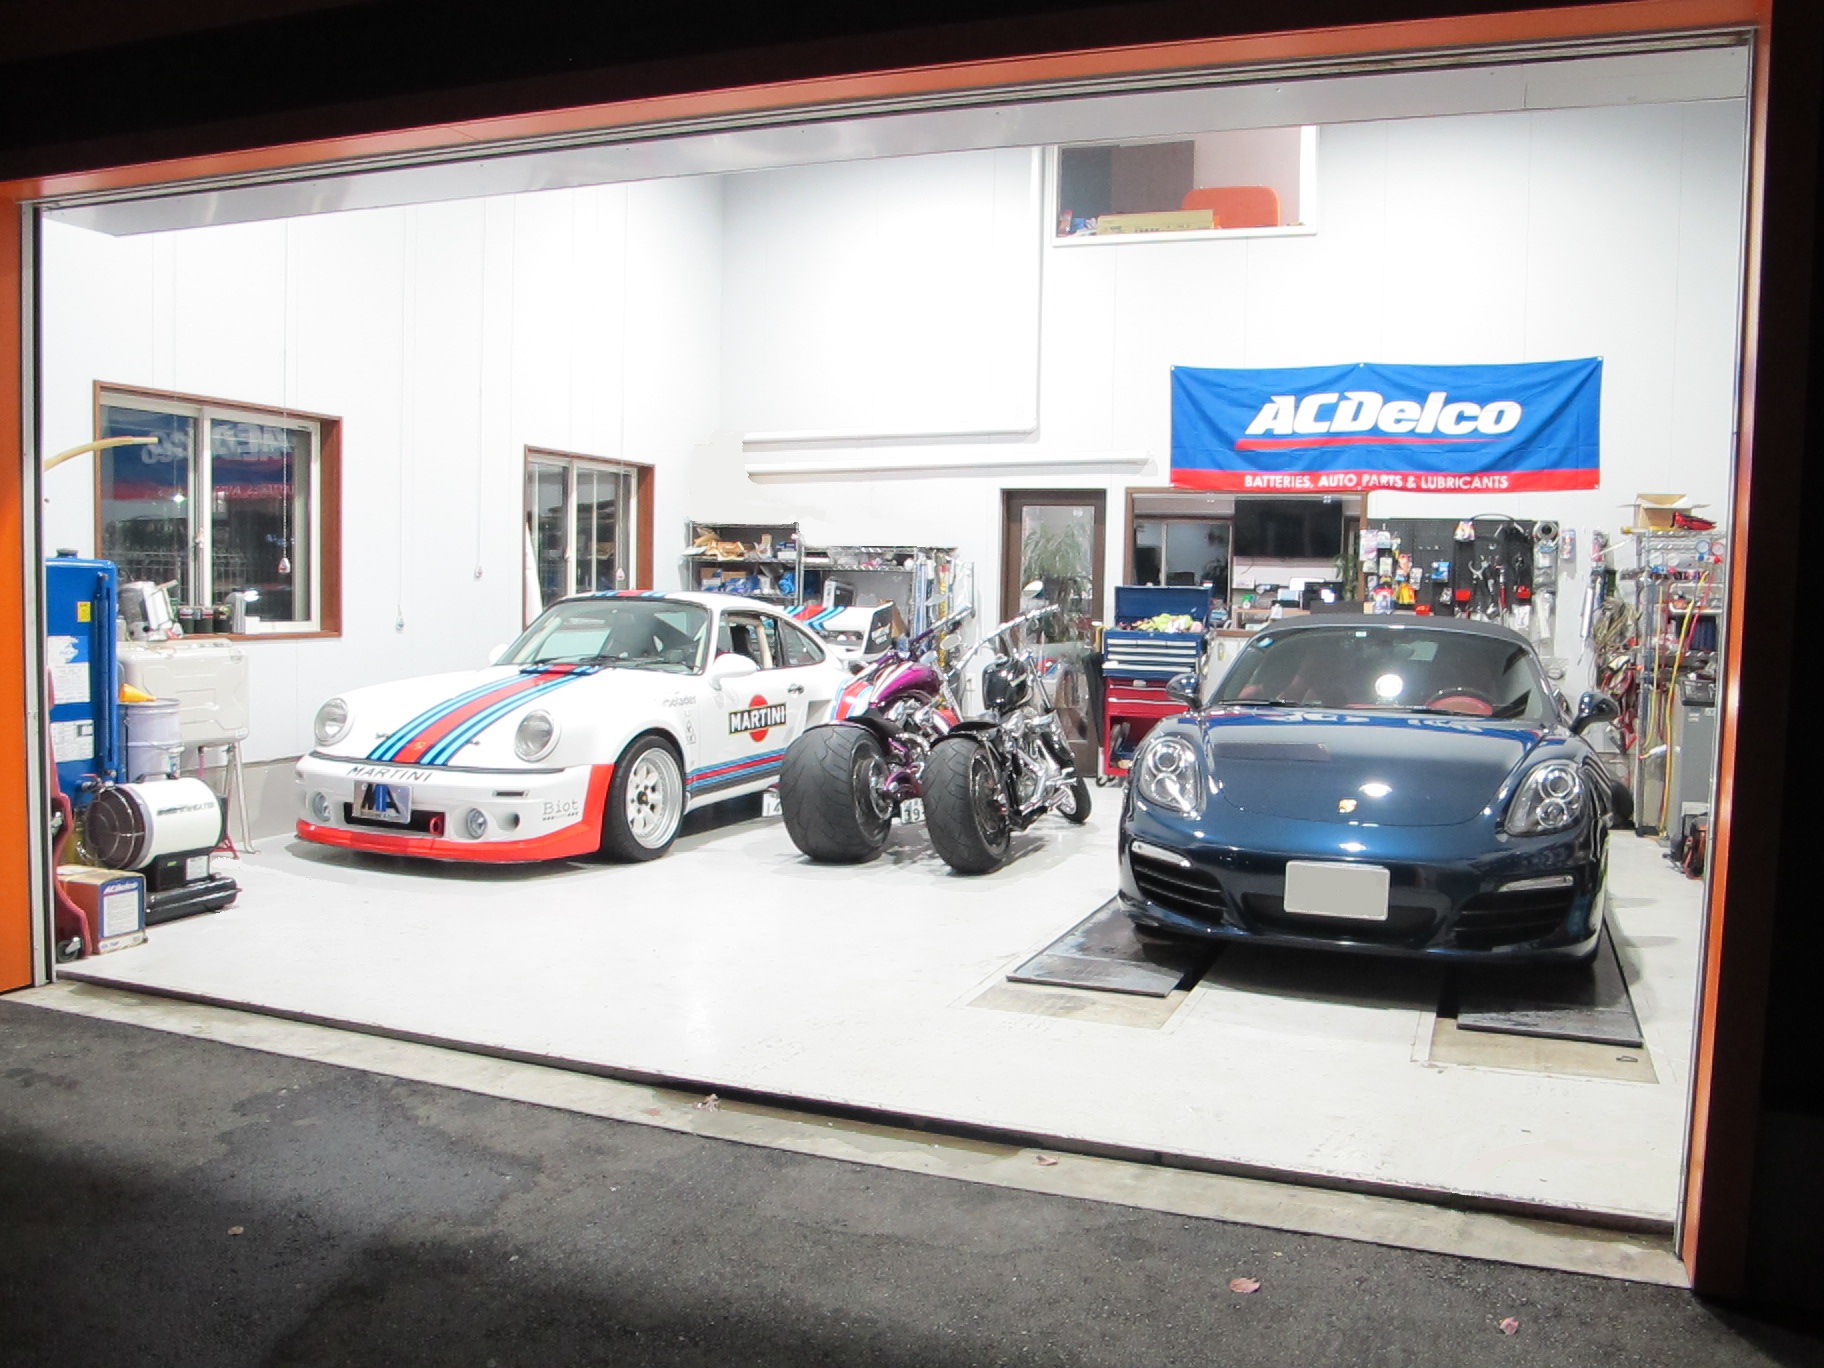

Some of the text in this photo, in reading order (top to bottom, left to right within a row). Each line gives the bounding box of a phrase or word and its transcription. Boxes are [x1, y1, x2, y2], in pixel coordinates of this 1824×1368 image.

[1244, 391, 1523, 435] ACDelco
[1244, 474, 1509, 489] BATTERIES, AUTO PARTS & LUBRICANTS
[730, 704, 786, 733] MARTINI
[346, 765, 434, 782] MARTINI
[543, 799, 579, 815] Biot
